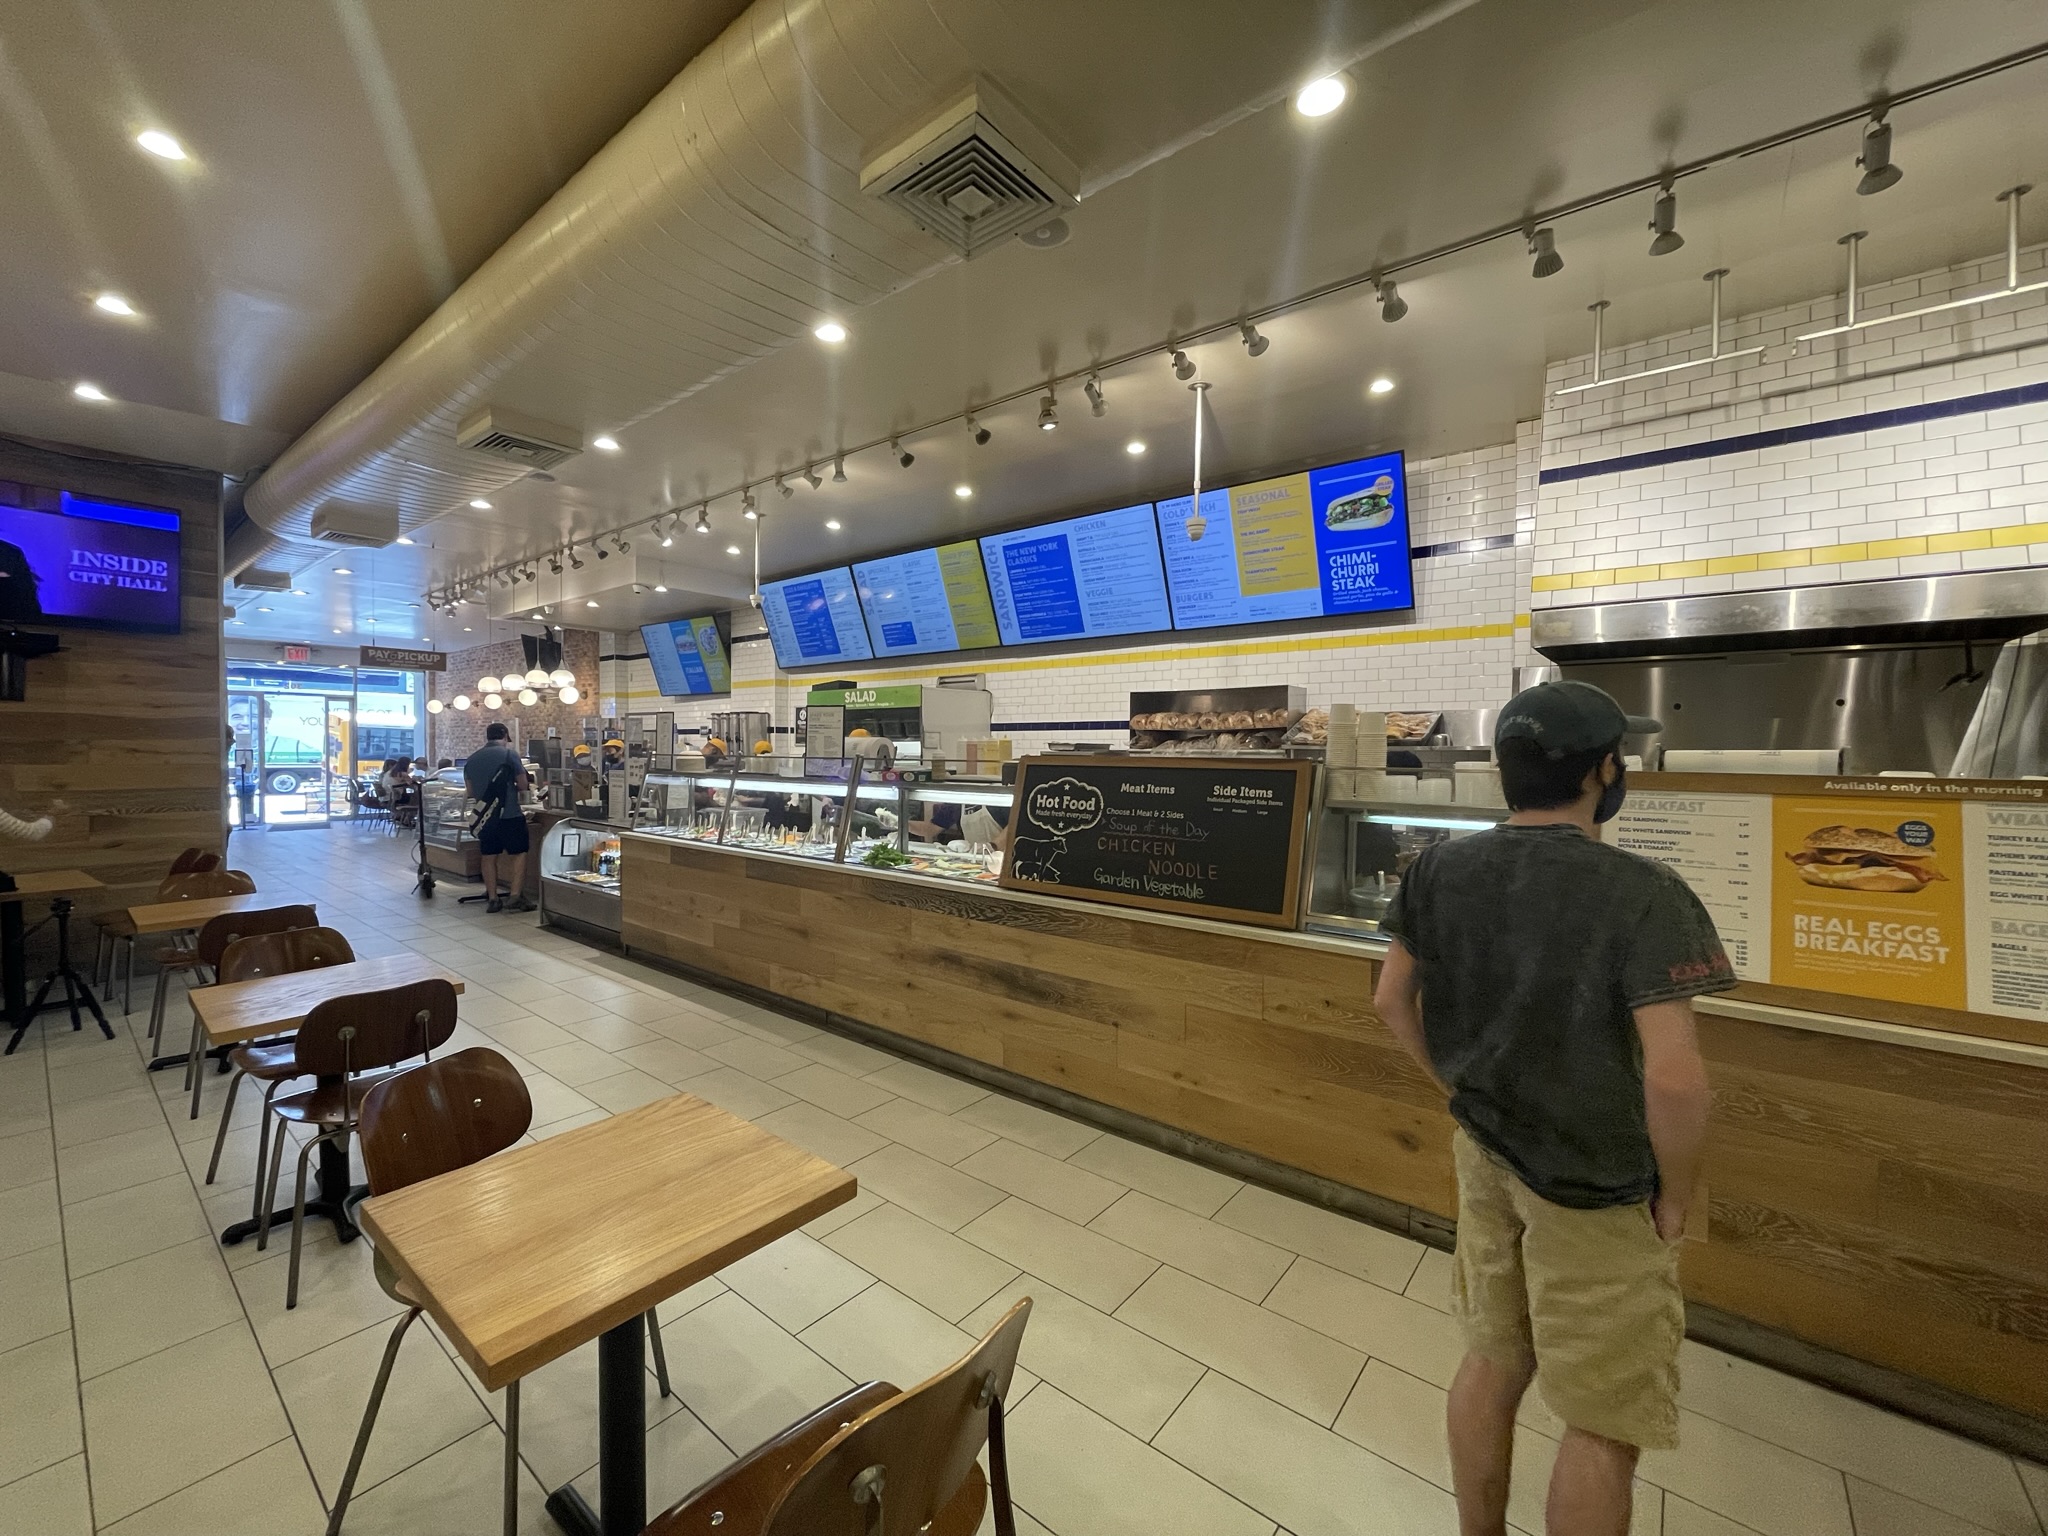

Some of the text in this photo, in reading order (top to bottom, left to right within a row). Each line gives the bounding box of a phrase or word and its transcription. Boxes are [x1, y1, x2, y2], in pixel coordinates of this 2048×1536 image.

[1236, 488, 1290, 506] SEASONAL
[1074, 520, 1106, 532] CHICKEN
[1006, 542, 1058, 558] THE NEW YORK
[70, 550, 168, 576] INSIDE
[1007, 555, 1038, 566] CLASSICS
[1330, 550, 1377, 567] CHIMI-
[1330, 562, 1380, 578] CHURRI
[68, 571, 168, 592] CITY HALL
[986, 544, 1013, 630] SANDWICH
[1332, 575, 1376, 591] STEAK
[1085, 588, 1114, 598] VEGGIE
[1176, 592, 1214, 603] BURGERS
[288, 648, 308, 660] EXIT
[368, 649, 390, 659] PAY
[398, 651, 440, 662] PICKUP
[844, 690, 876, 703] SALAD
[1120, 783, 1176, 794] Meat Items
[1213, 785, 1273, 798] Side Items
[1824, 781, 2044, 797] Available only in the morning
[1036, 794, 1096, 810] Hot Food
[1051, 810, 1066, 818] fresh
[1066, 812, 1094, 820] everyday
[1106, 808, 1131, 816] Choose
[1136, 809, 1153, 817] Meat
[1154, 810, 1160, 818] &
[1166, 811, 1184, 819] Sides
[1987, 812, 2048, 826] WRA
[1108, 816, 1210, 840] Soup of the Day
[1632, 838, 1668, 846] SANDWICH
[1987, 834, 2024, 842] TURKEY
[1098, 836, 1176, 856] CHICKEN
[1988, 852, 2026, 860] ATHENS
[1148, 860, 1218, 880] NOODLE
[1988, 869, 2038, 878] PASTRAMI
[1094, 868, 1206, 899] Garden Vegetable
[2010, 892, 2044, 900] WHITE
[1794, 914, 1941, 944] REAL EGGS
[1794, 932, 1950, 964] BREAKFAST
[1991, 942, 2028, 952] BAGELS
